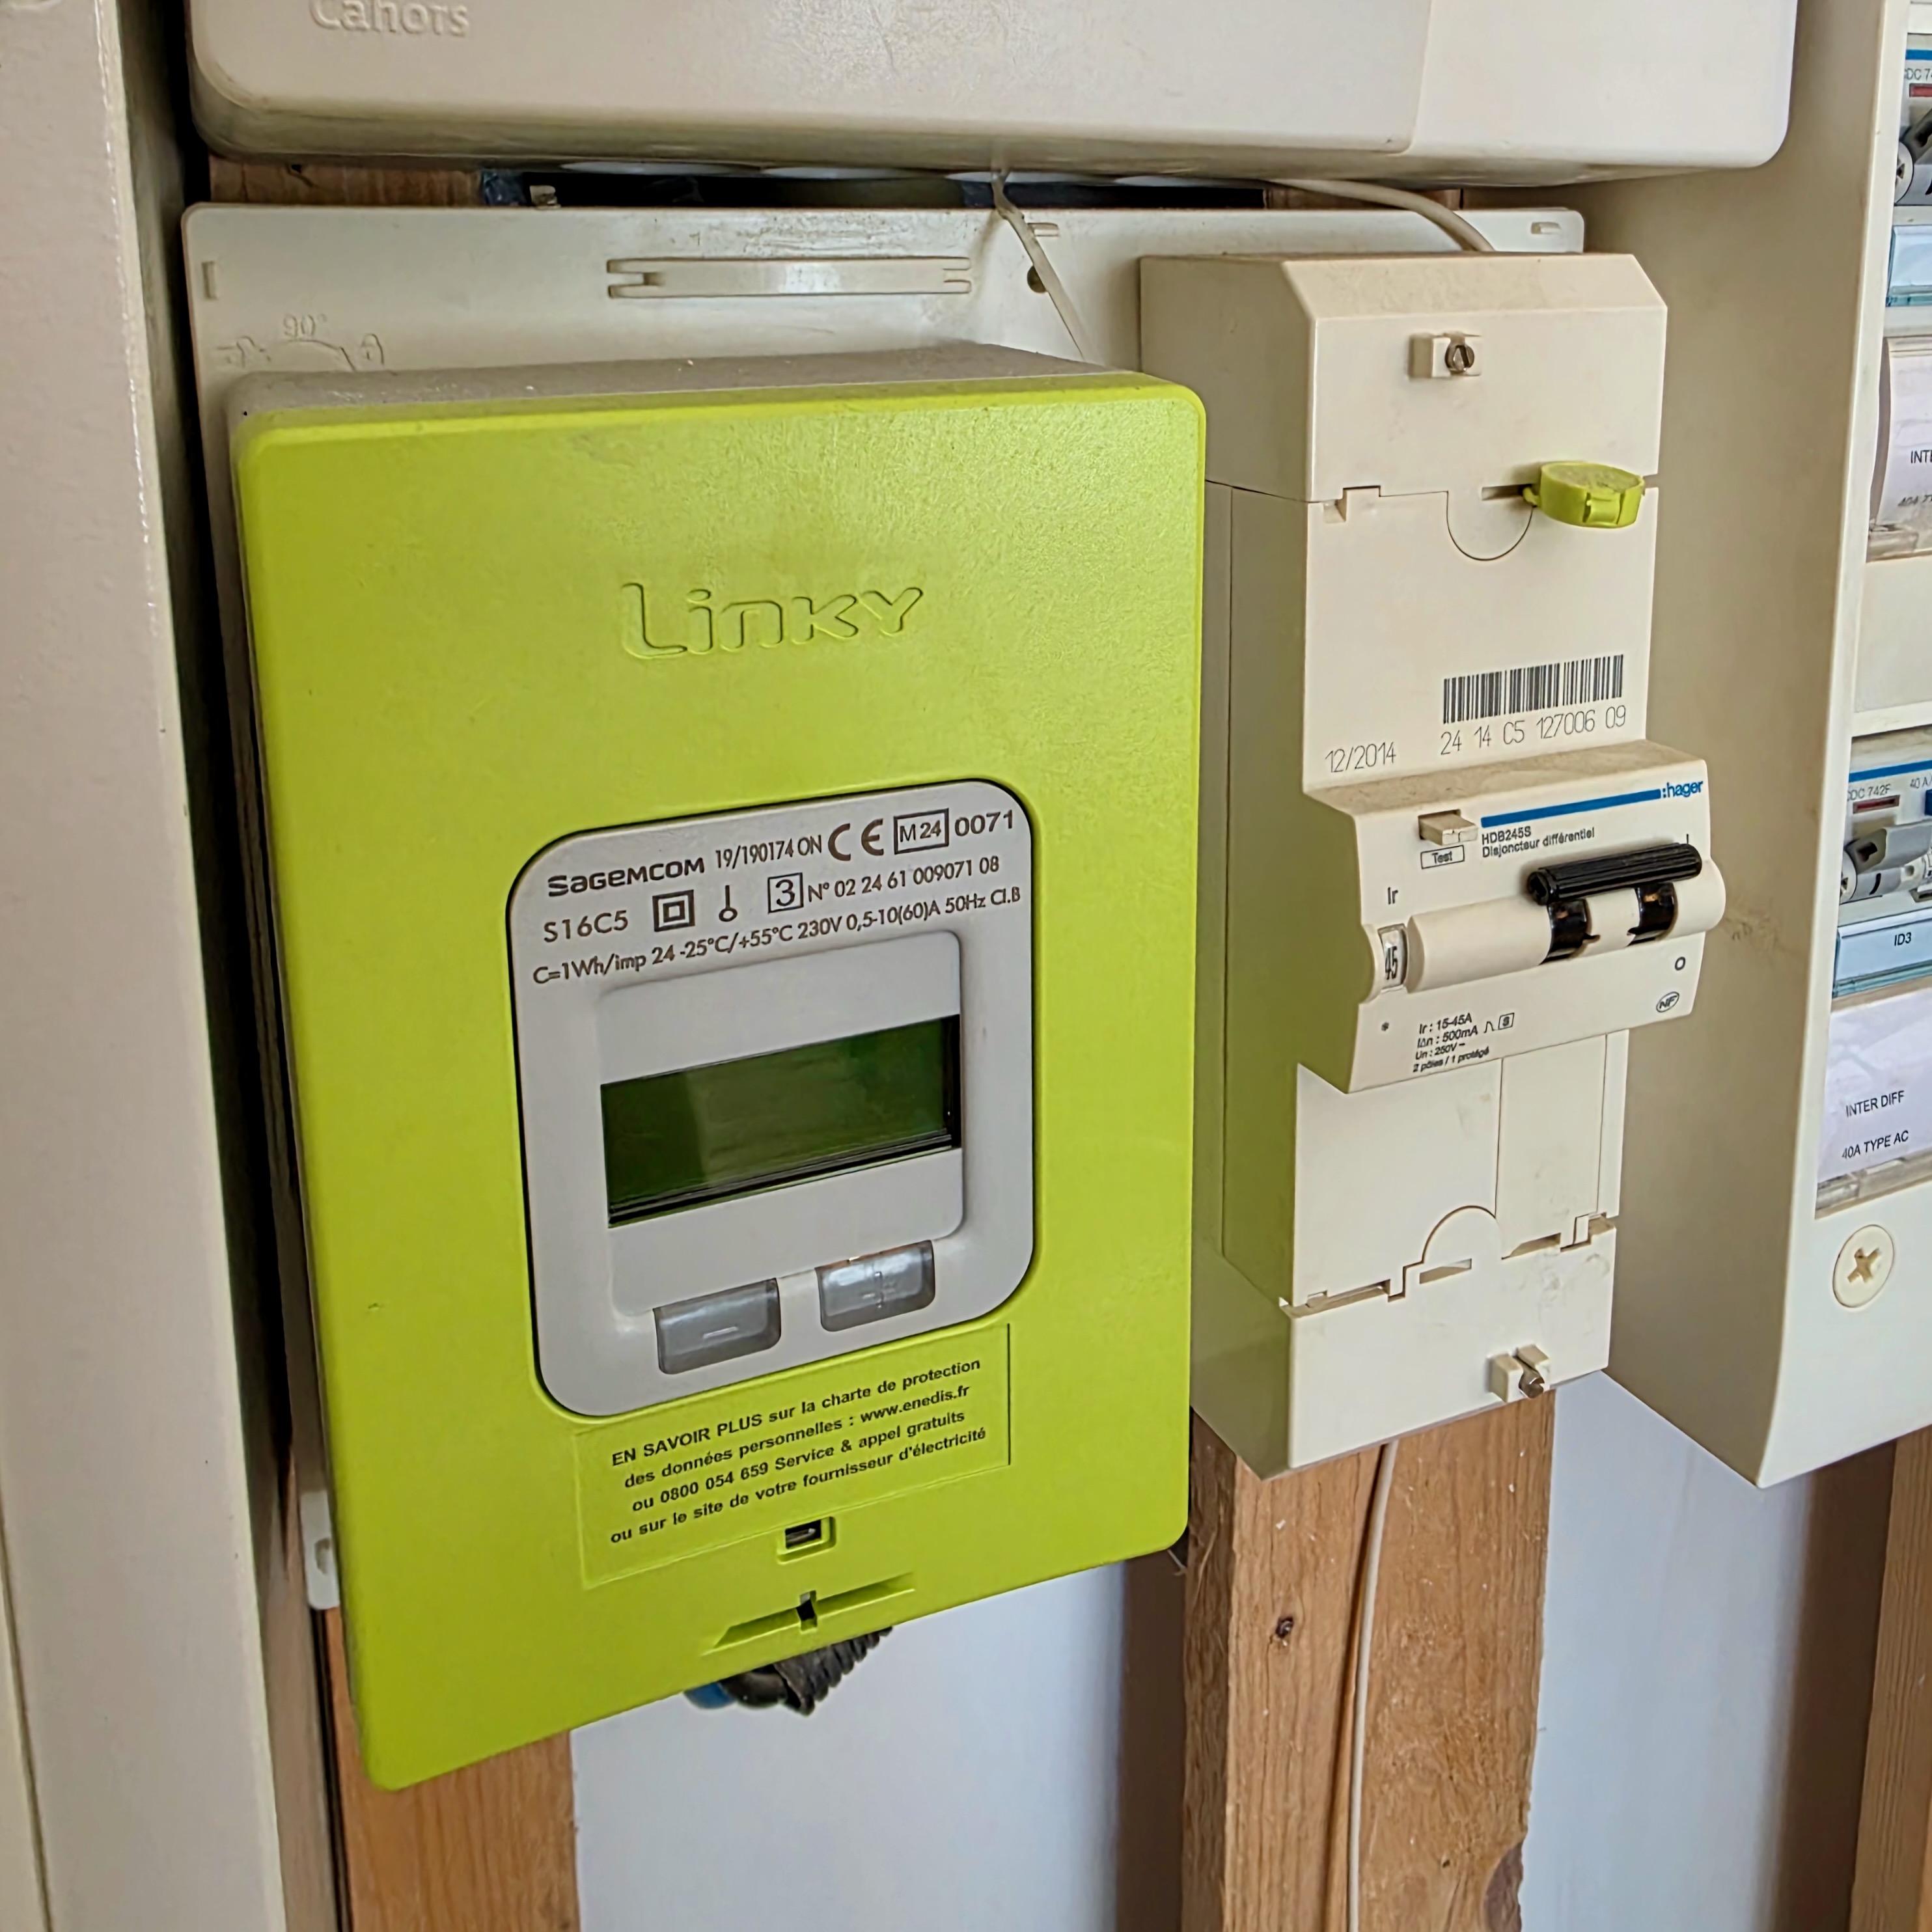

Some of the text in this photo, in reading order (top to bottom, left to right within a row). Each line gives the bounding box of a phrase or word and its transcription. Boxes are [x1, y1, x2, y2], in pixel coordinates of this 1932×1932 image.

[1904, 68, 1932, 81] DC 7
[1441, 730, 1462, 755] 24
[1474, 724, 1491, 749] 14
[1536, 710, 1595, 741] 127006
[1605, 705, 1626, 730] 09
[1325, 741, 1396, 773] 12/2014
[1847, 788, 1865, 801] DC
[954, 809, 1013, 837] 0071
[1482, 826, 1532, 846] HDB245S
[1482, 827, 1595, 859] Disjoncteur différentiel
[1431, 851, 1453, 864] Test
[544, 910, 629, 943] S16C5
[775, 879, 795, 907] 3
[834, 879, 856, 898] 02
[861, 874, 882, 894] 24
[887, 870, 905, 889] 61
[913, 859, 972, 885] 009071
[979, 855, 999, 874] 08
[532, 953, 646, 984] C=1Wh/imp
[652, 945, 675, 965] 24
[797, 916, 842, 940] 230V
[846, 900, 941, 932] 0,5-10(60)A
[945, 892, 986, 913] 50Hz
[1894, 932, 1912, 946] ID3
[1385, 946, 1398, 980] 45
[1659, 995, 1677, 1010] NF
[1437, 1012, 1472, 1030] 15-45A
[1442, 1025, 1478, 1043] 500mA
[1415, 1051, 1428, 1060] Un
[1845, 1090, 1905, 1118] INTER DIFF
[1842, 1130, 1909, 1159] 40A TYPE AC
[612, 1359, 980, 1466] EN SAVOIR PLUS sur la charte de protection
[625, 1470, 656, 1488] des
[661, 1449, 733, 1478] données
[739, 1418, 842, 1459] personnelles
[860, 1384, 970, 1423] www.enedis.fr
[632, 1410, 965, 1511] ou 0800 054 659 Service & appel gratuits
[611, 1427, 986, 1543] ou sur le site de votre fournisseur d'électricité
